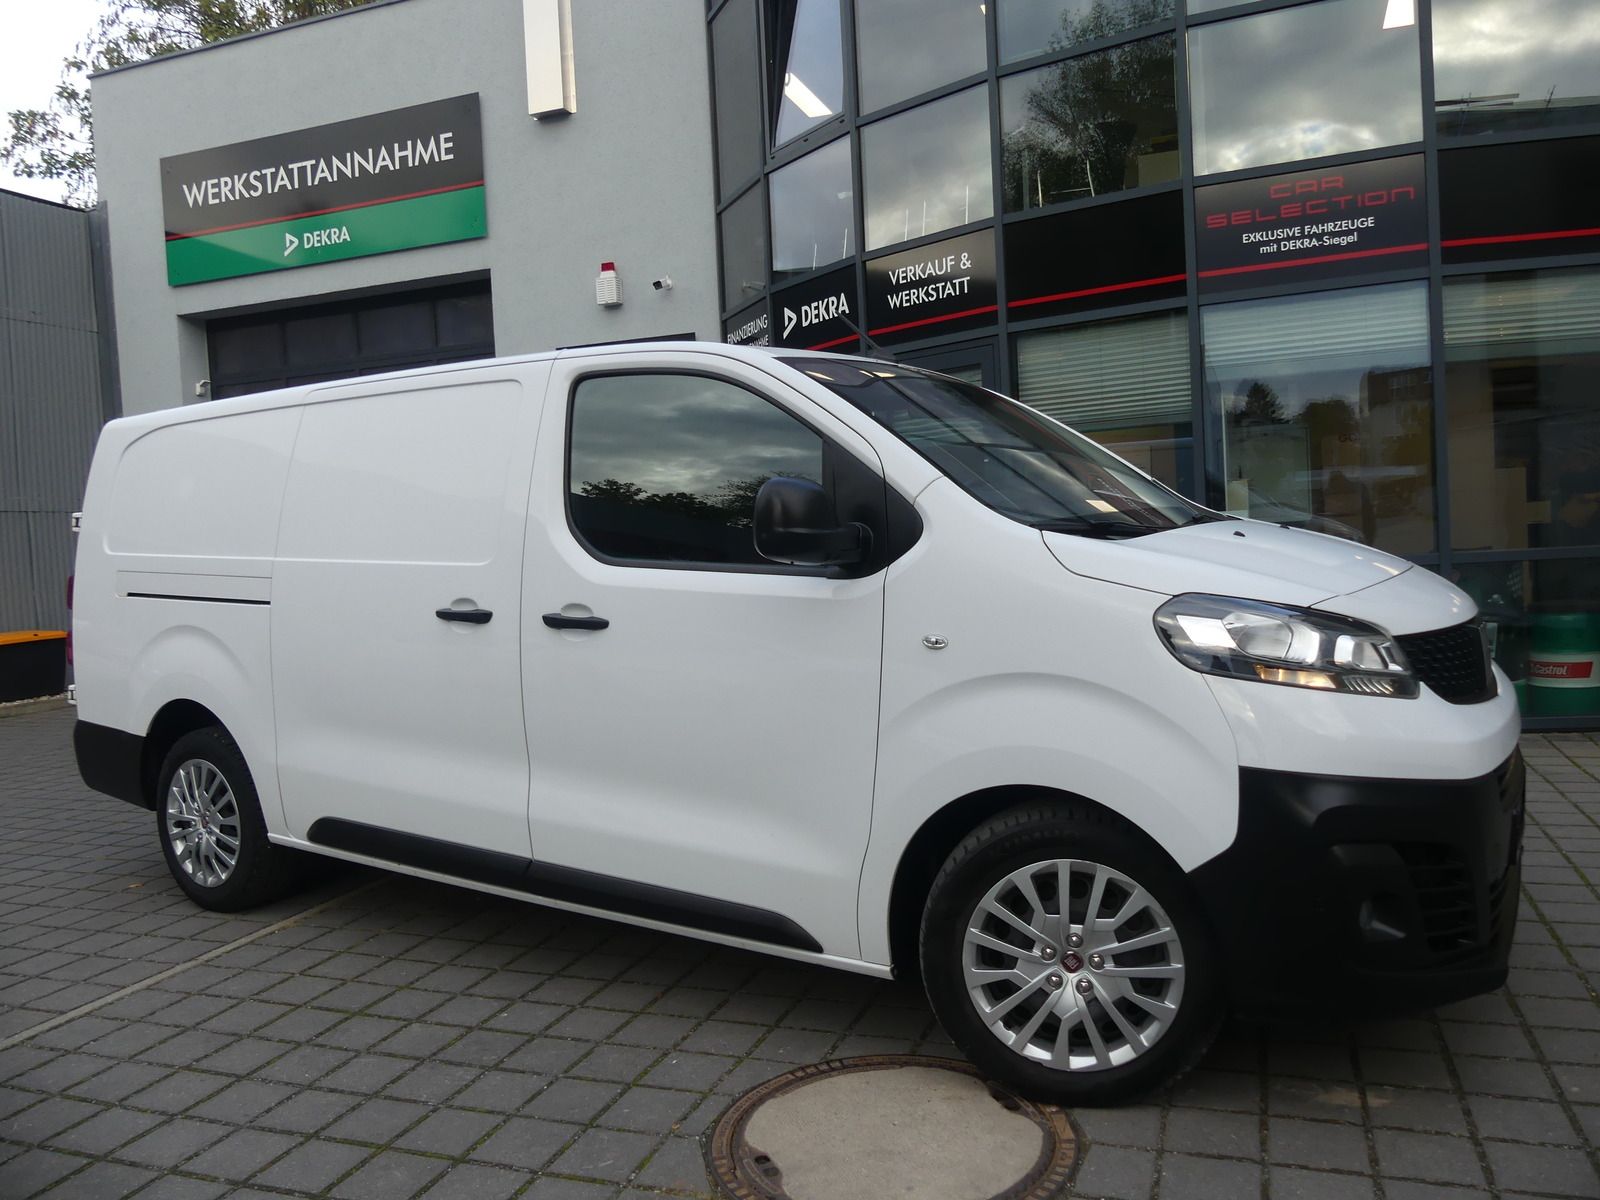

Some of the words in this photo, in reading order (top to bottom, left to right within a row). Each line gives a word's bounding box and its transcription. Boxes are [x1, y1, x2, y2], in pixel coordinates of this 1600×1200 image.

[182, 132, 454, 208] WERKSTATTANNAHME
[1269, 176, 1345, 199] CAR
[303, 225, 351, 249] DEKRA
[1242, 226, 1302, 244] EXKLUSIVE
[1304, 217, 1375, 235] FAHRZEUGE
[1259, 243, 1277, 254] mit
[1281, 232, 1358, 251] DEKRA-Siegel
[889, 255, 955, 286] VERKAUF
[960, 252, 972, 269] &
[887, 277, 971, 310] WERKSTATT
[801, 292, 850, 327] DEKRA
[727, 314, 768, 345] FINANZIERUNG
[1535, 664, 1568, 675] Castrol
